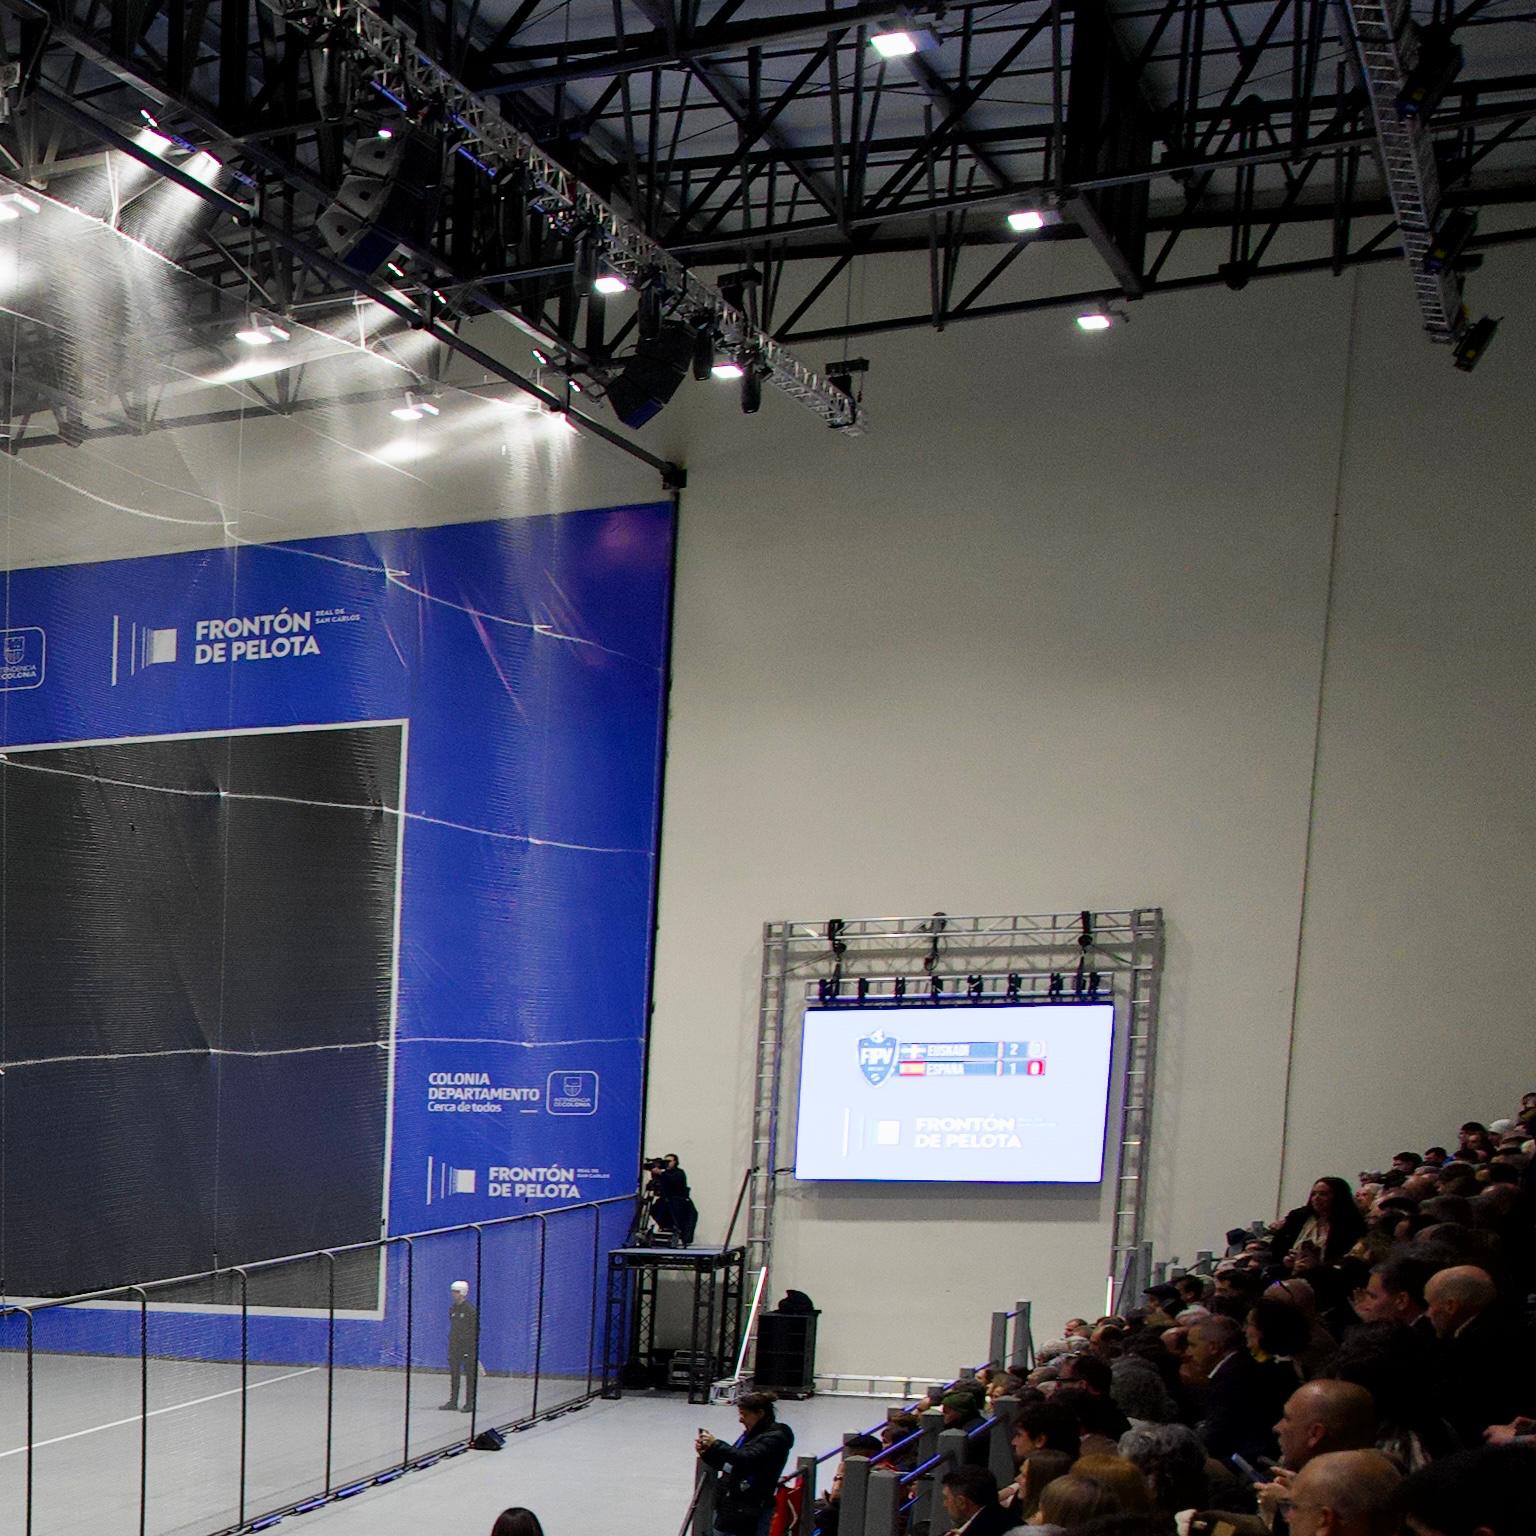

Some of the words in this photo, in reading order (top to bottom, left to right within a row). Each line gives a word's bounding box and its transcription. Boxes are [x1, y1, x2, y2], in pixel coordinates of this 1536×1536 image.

[195, 606, 312, 641] FRONTÓN
[194, 642, 227, 665] DE
[231, 635, 321, 661] PELOTA
[428, 1072, 491, 1086] COLONIA
[428, 1087, 541, 1101] DEPARTAMENTO
[428, 1101, 457, 1113] Cerca
[458, 1101, 471, 1113] de
[472, 1101, 503, 1113] todos
[914, 1113, 1016, 1132] FRONTÓN
[913, 1133, 942, 1148] DE
[944, 1133, 1022, 1148] PELOTA
[488, 1163, 576, 1182] FRONTÓN
[488, 1183, 513, 1198] DE
[514, 1183, 581, 1199] PELOTA
